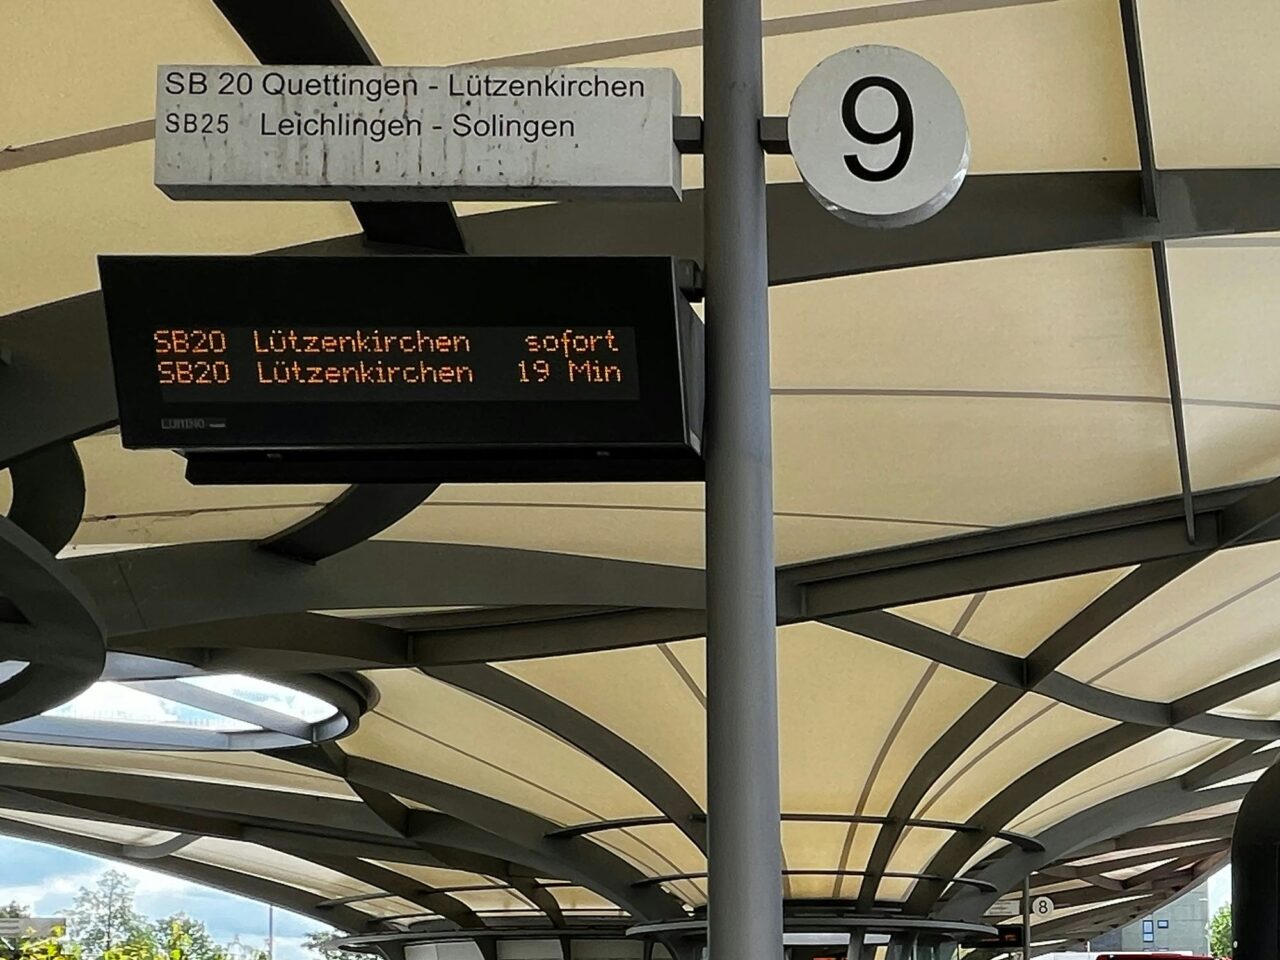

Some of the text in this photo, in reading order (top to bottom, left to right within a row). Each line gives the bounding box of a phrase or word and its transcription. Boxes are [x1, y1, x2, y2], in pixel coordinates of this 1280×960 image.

[165, 71, 208, 96] SB
[217, 71, 253, 96] 20
[262, 72, 418, 102] Quettingen
[449, 73, 645, 97] Lützenkirchen
[165, 112, 229, 134] SB25
[260, 112, 422, 142] Leichlingen
[452, 113, 575, 143] Solingen
[841, 75, 914, 183] 9
[153, 329, 619, 358] SB20 Lützenkirchen sofort
[157, 359, 622, 384] SB20 Lützenkirchen 19 Min
[1038, 899, 1049, 914] 8
